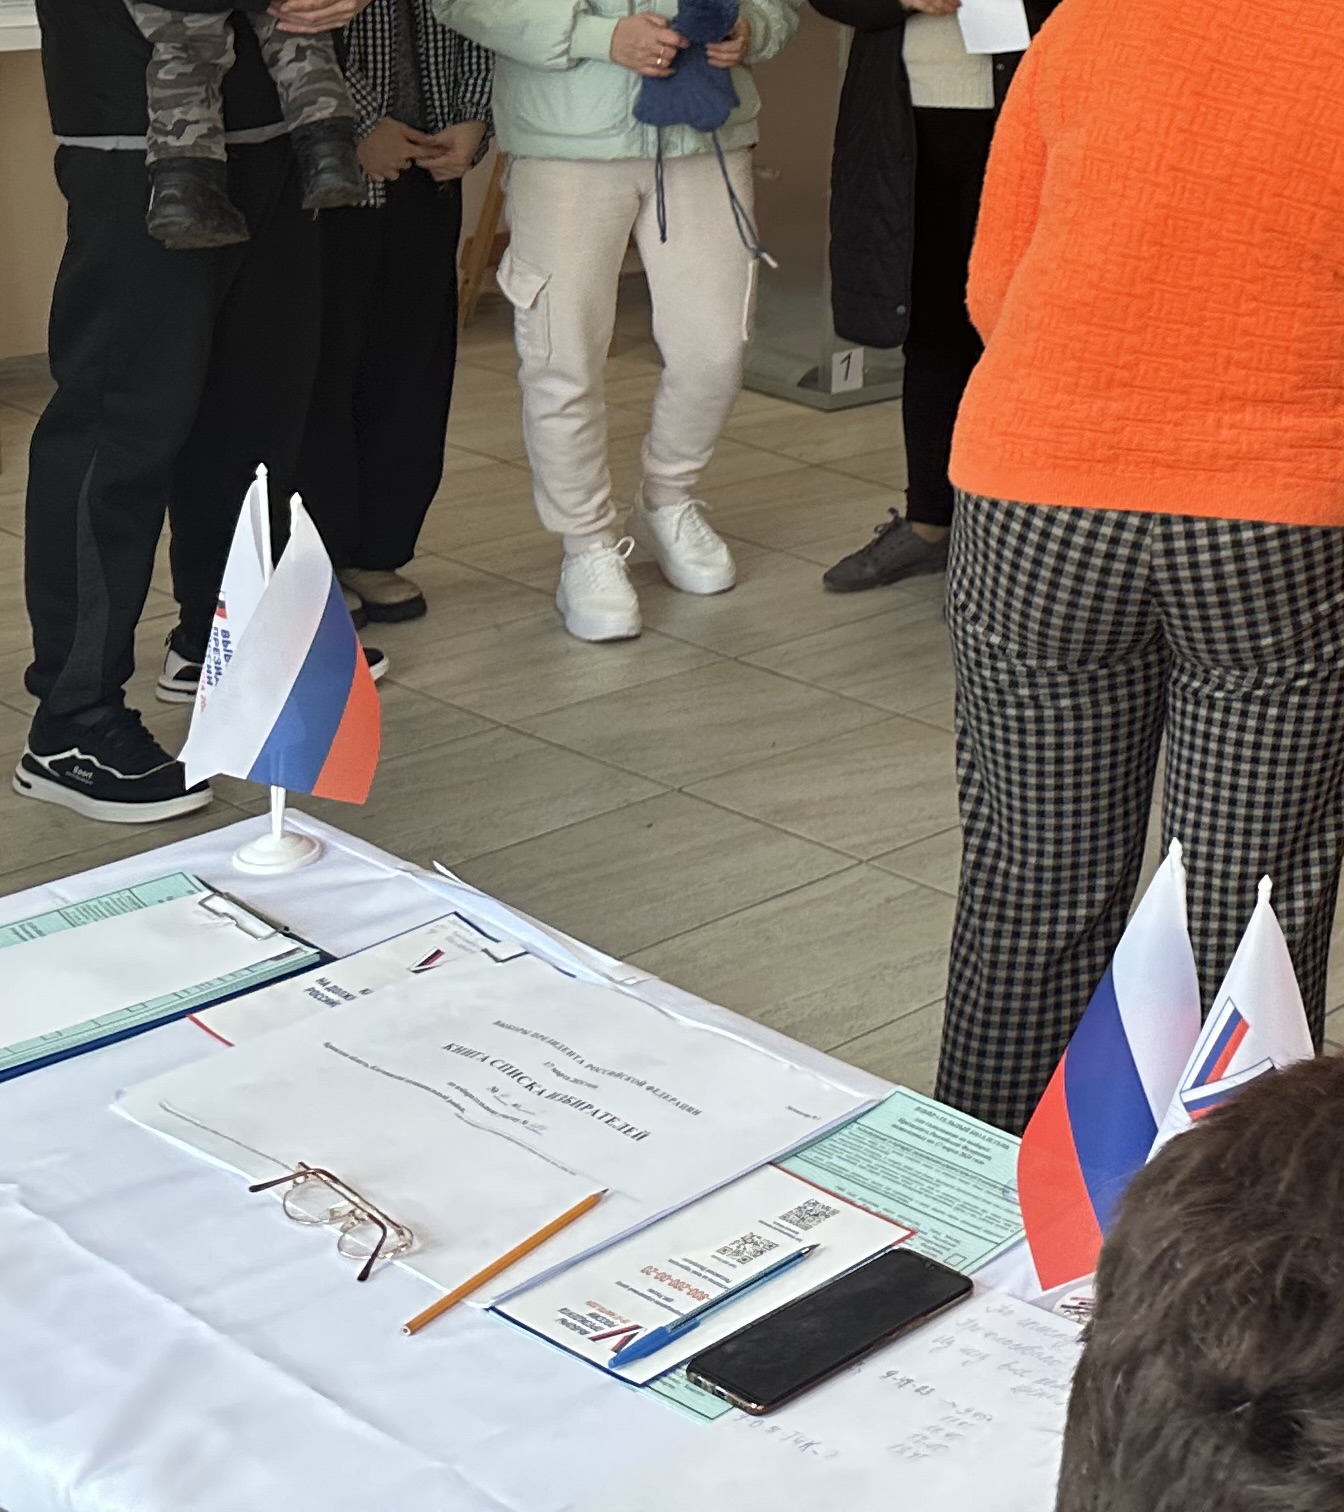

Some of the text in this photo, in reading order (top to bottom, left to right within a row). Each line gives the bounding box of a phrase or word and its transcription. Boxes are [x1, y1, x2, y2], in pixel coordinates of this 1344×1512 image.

[840, 351, 852, 382] 1
[442, 1042, 491, 1063] КНИГА
[489, 1058, 546, 1097] СПИСКА
[544, 1091, 652, 1142] ИЗБИРАТЕЛЕЙ
